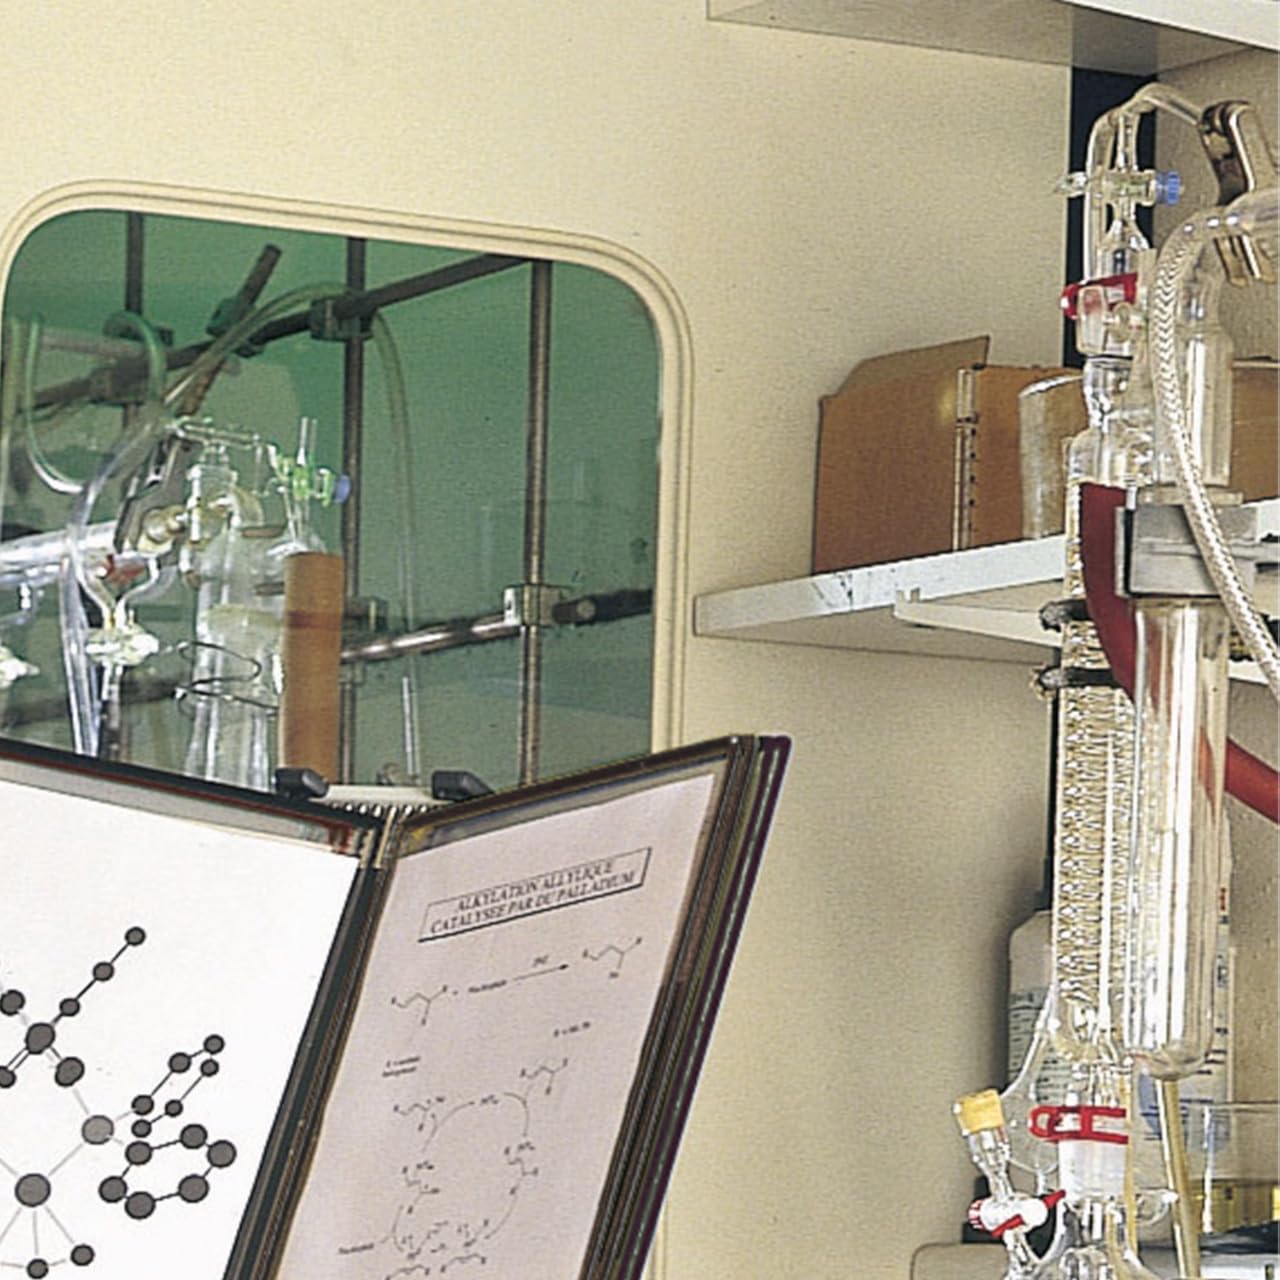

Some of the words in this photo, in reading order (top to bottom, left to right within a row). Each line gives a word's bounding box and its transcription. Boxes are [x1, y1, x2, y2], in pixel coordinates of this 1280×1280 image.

[507, 897, 533, 915] PAR
[534, 891, 553, 907] DU
[557, 871, 634, 901] PALLADIUM
